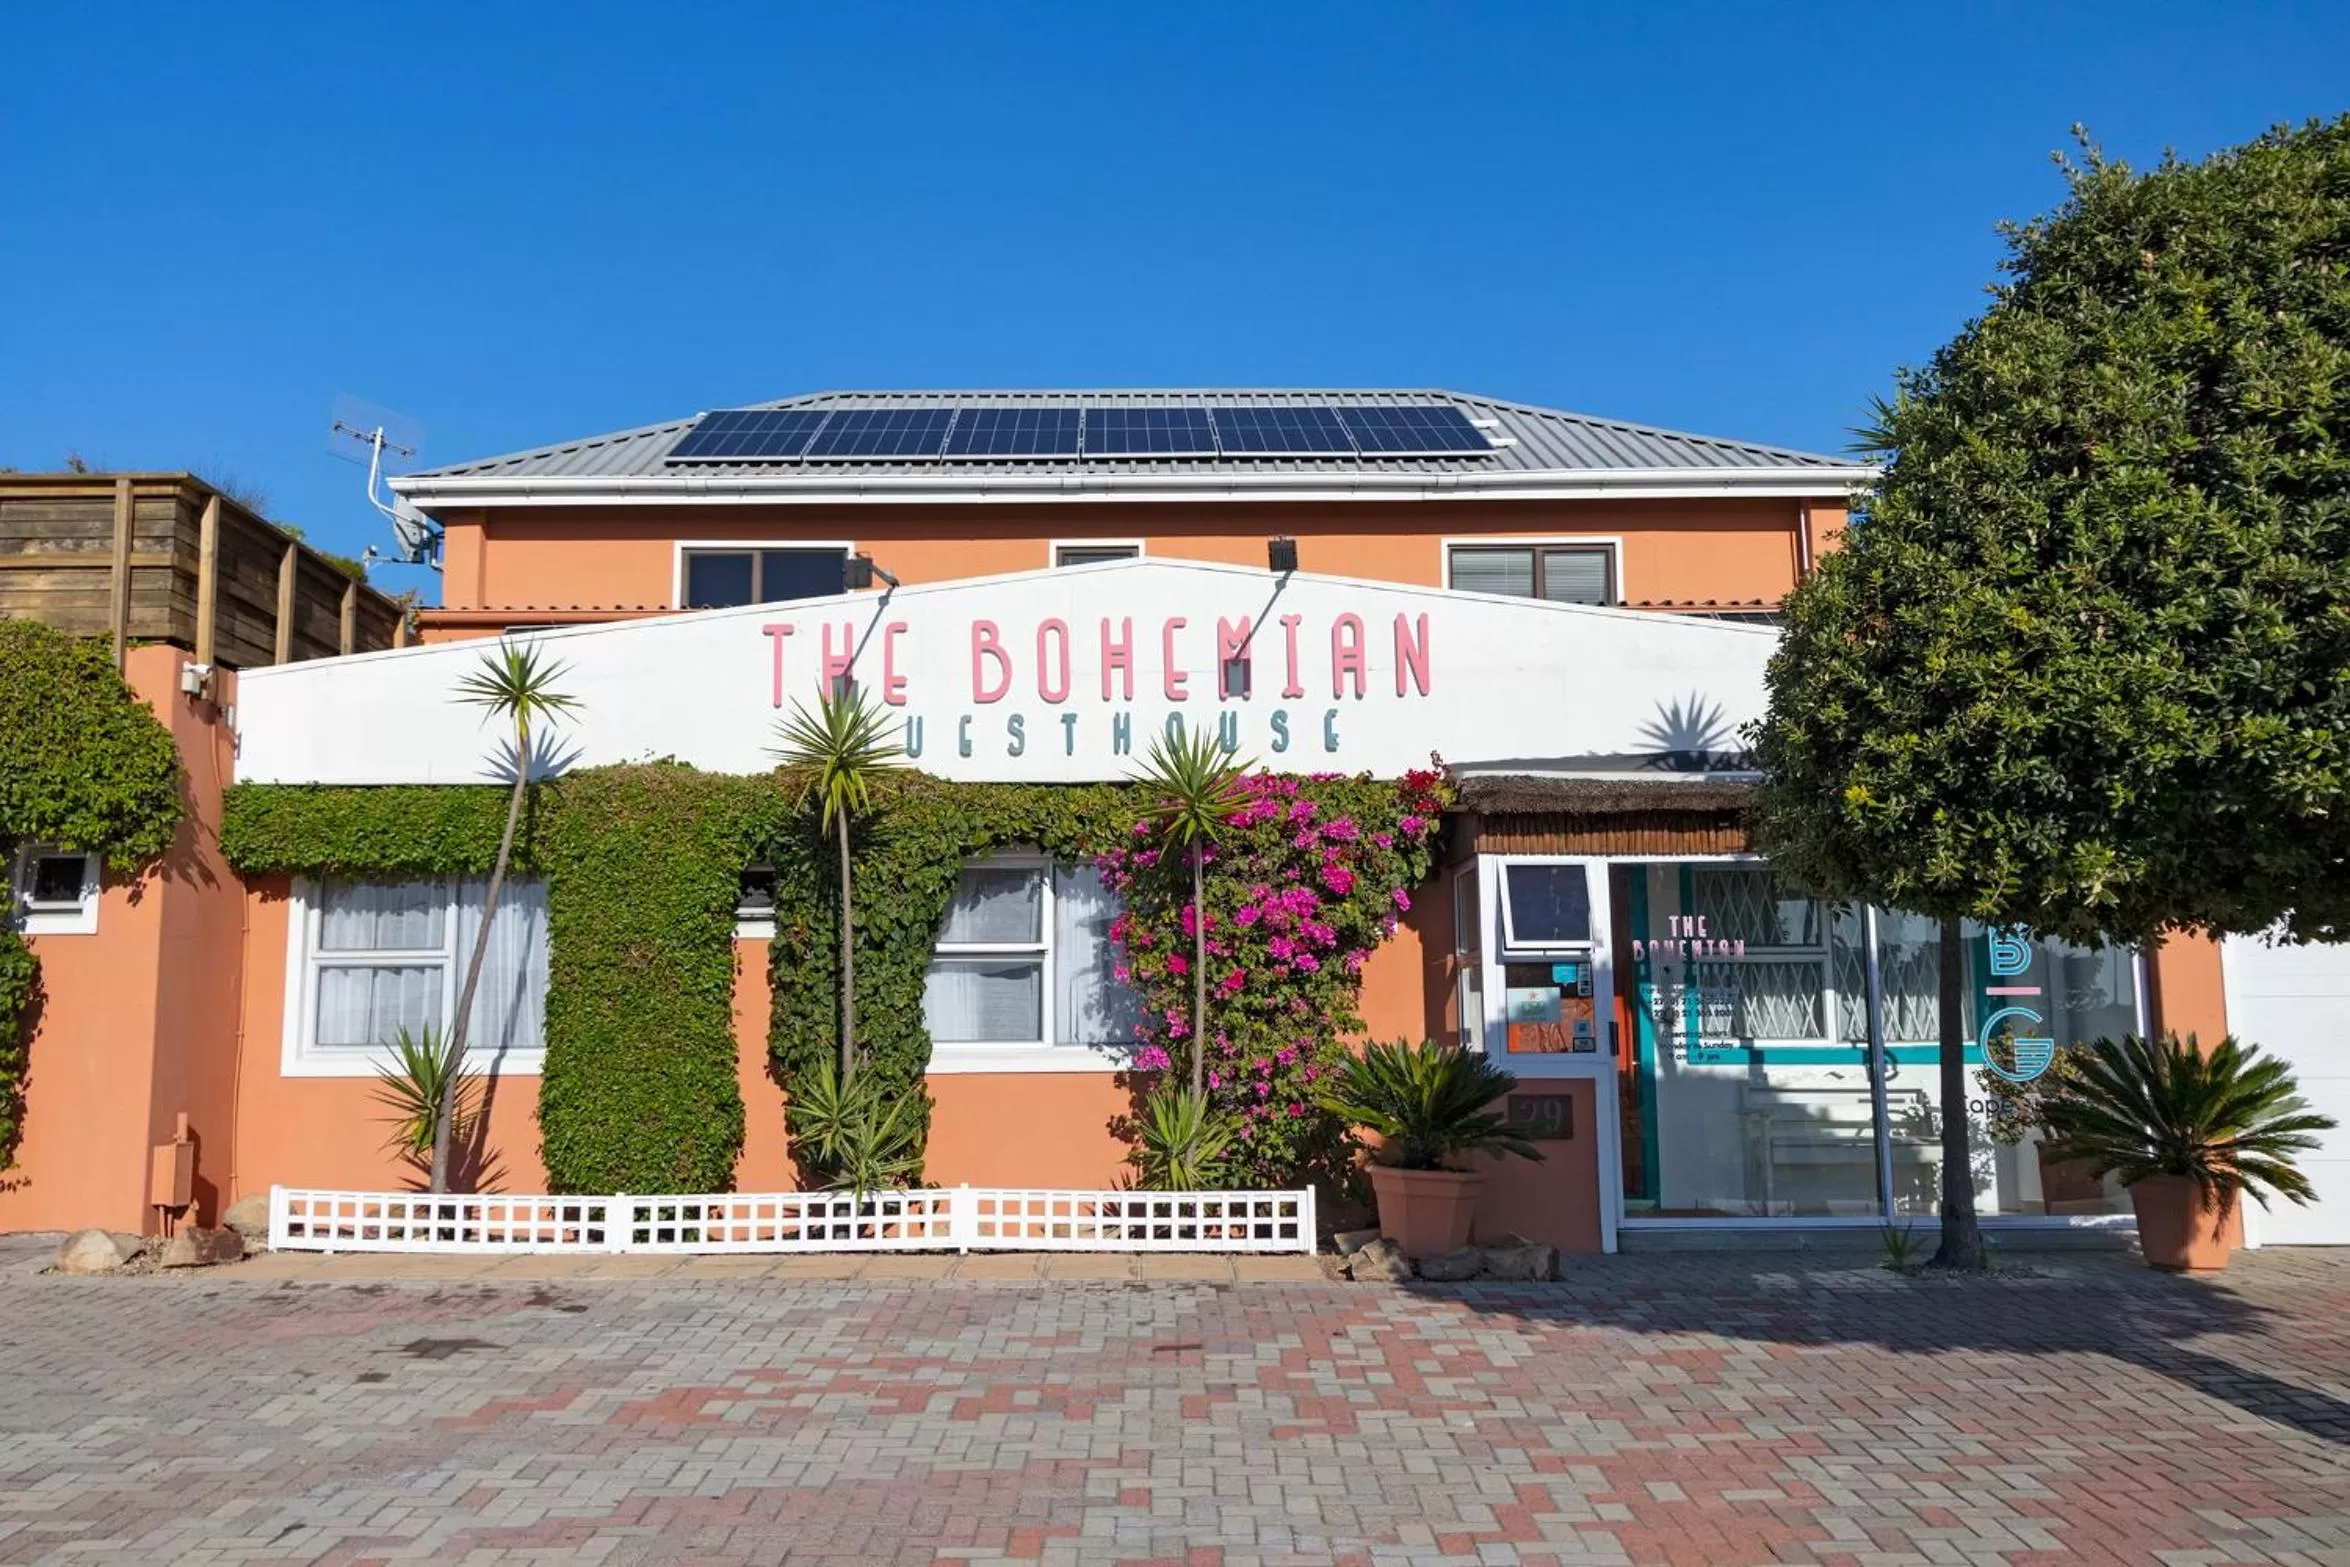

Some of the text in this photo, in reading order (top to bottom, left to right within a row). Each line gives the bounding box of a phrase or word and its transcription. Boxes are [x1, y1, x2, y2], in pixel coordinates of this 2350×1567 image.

[762, 611, 1431, 707] THE BOHEMIAN
[858, 708, 1340, 760] UESTHOUSE
[1668, 915, 1707, 938] THE
